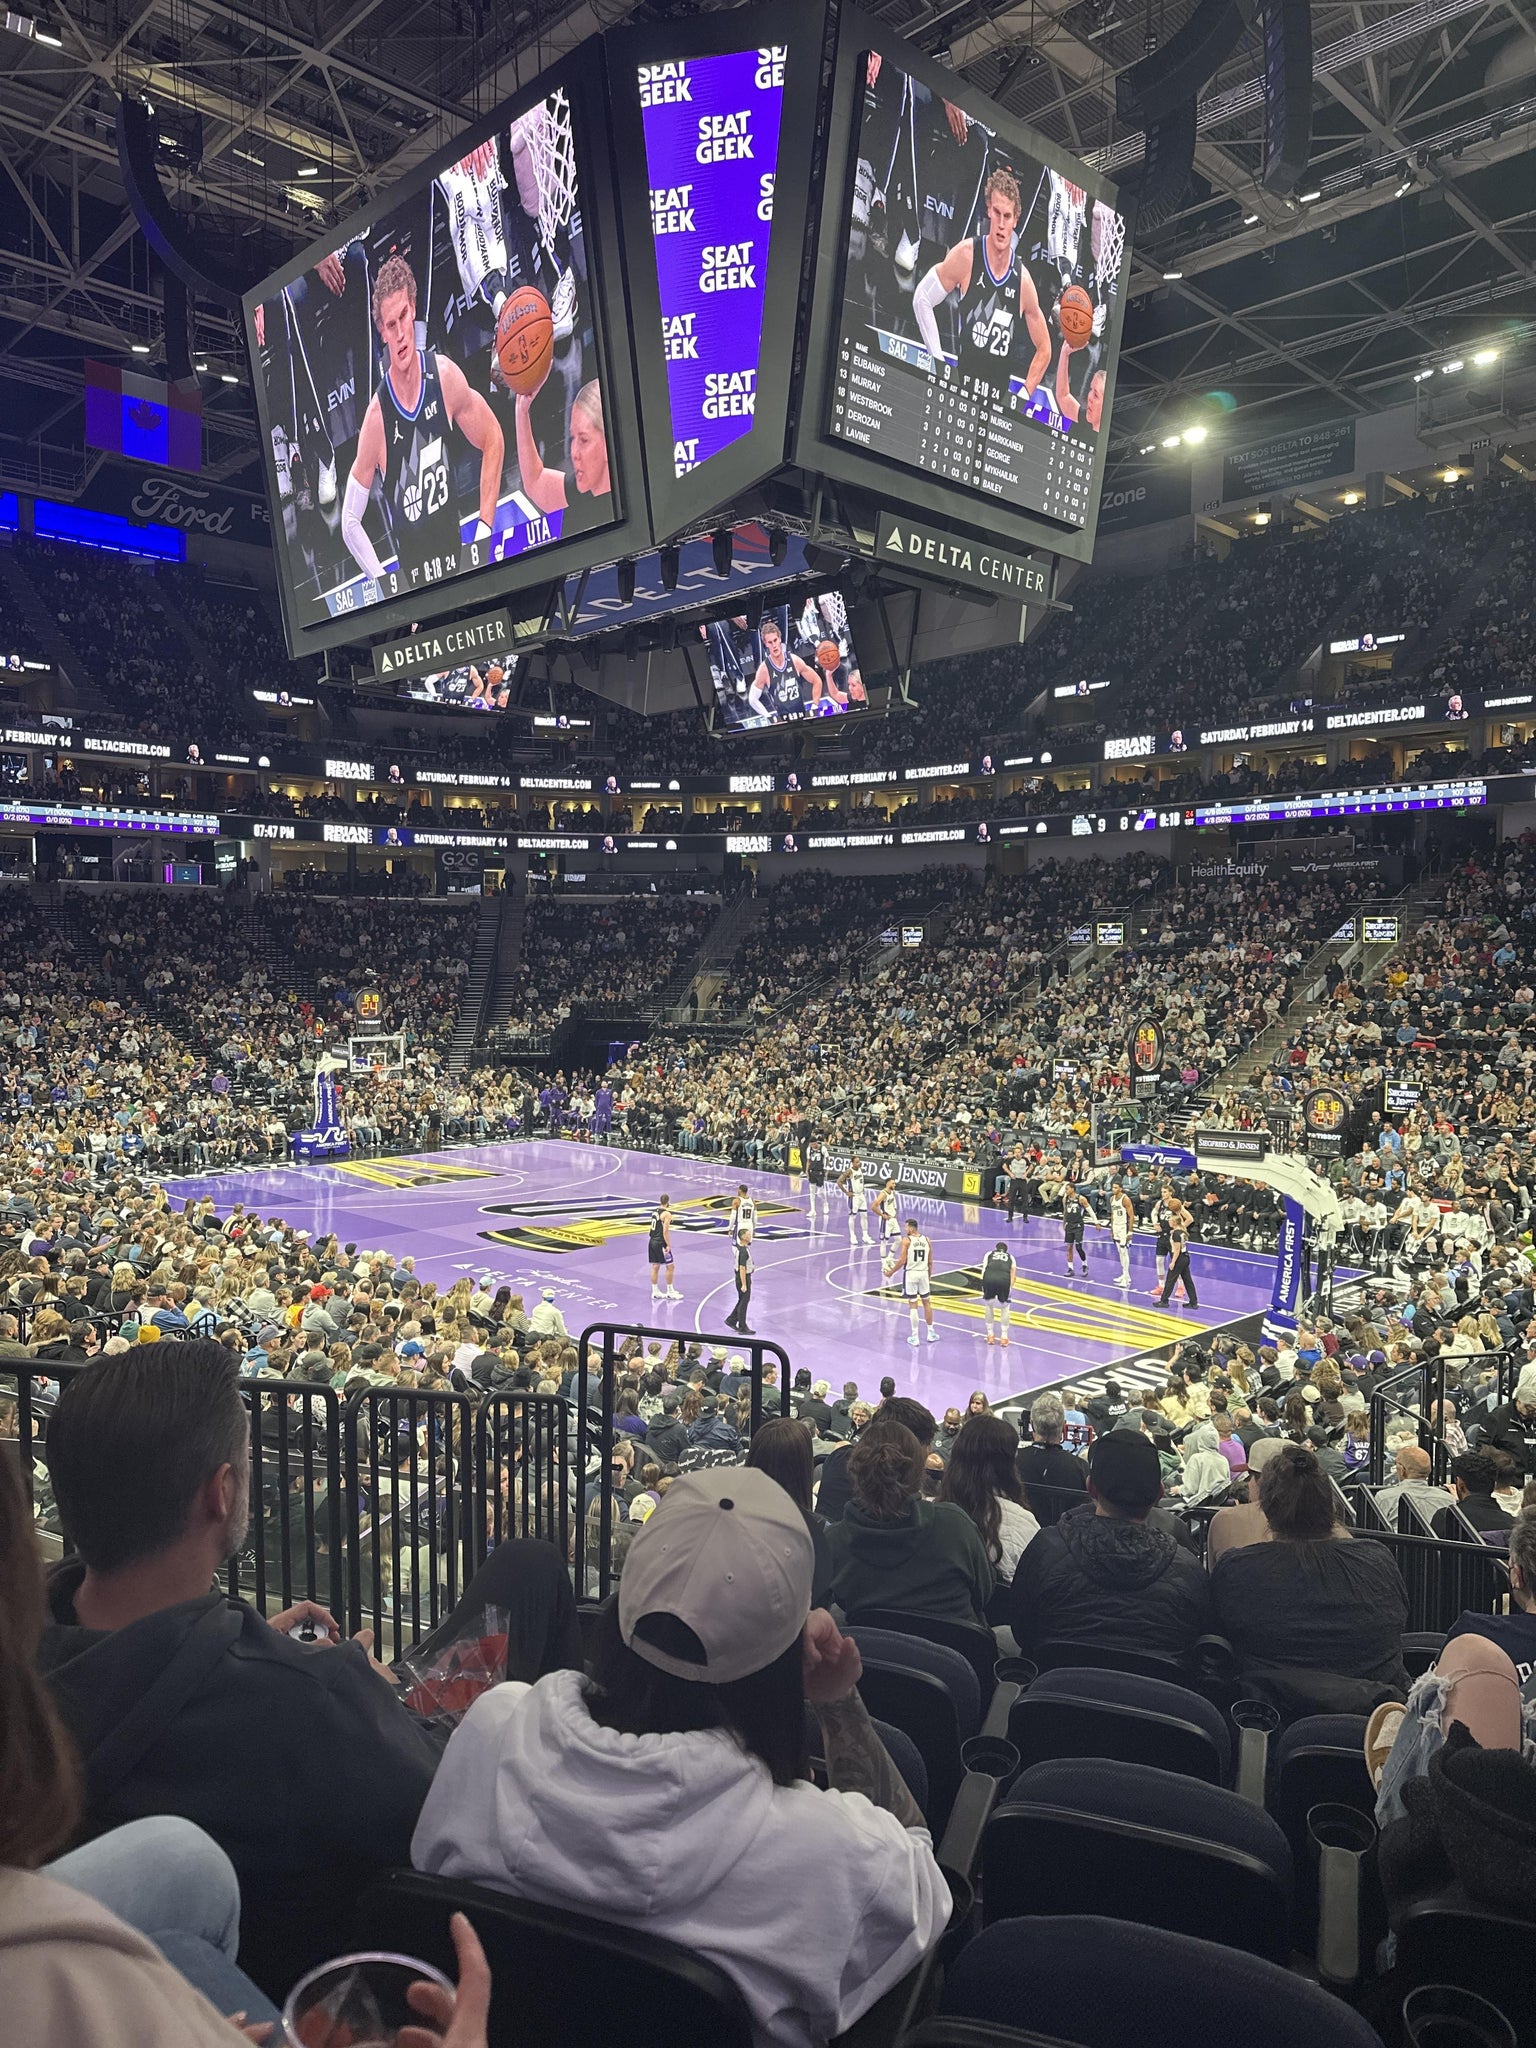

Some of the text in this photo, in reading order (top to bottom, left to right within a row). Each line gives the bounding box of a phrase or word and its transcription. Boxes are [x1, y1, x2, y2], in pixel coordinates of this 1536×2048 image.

[757, 45, 787, 65] SE
[638, 61, 686, 83] SEAT
[755, 64, 785, 90] GE
[640, 78, 693, 108] GEEK
[698, 110, 752, 140] SEAT
[696, 134, 754, 165] GEEK
[653, 208, 696, 235] EEK
[702, 241, 754, 270] SEAT
[699, 264, 756, 293] GEEK
[501, 302, 538, 334] Wilson
[661, 312, 697, 337] EAT
[664, 336, 699, 360] EEK
[888, 338, 908, 360] SAC
[990, 326, 1011, 357] 23
[704, 368, 756, 397] SEAT
[840, 369, 881, 392] 13 MURRAY
[841, 351, 975, 416] 19 EUBANKS 0 0 0 03 0
[944, 364, 951, 380] 9
[974, 378, 989, 398] 8:18
[991, 387, 1000, 400] 24
[702, 391, 755, 420] GEEK
[838, 386, 892, 416] 18 WESTBROOK
[1010, 395, 1017, 410] 8
[836, 405, 880, 430] 10 DEROZAN
[980, 411, 988, 420] 30
[1048, 411, 1063, 431] UTA
[835, 423, 870, 444] 8 LAVINE
[978, 427, 985, 436] 23
[674, 438, 699, 461] AT
[978, 444, 1011, 464] 3 GEORGE
[1229, 452, 1250, 465] TEXT
[1251, 447, 1269, 460] SOS
[1270, 441, 1297, 454] DELTA
[1299, 436, 1312, 447] TO
[1471, 439, 1489, 449] HH
[975, 460, 981, 469] 10
[424, 464, 449, 514] 23
[973, 476, 1003, 493] 19 BAILEY
[131, 478, 234, 535] Ford
[1102, 487, 1146, 510] Zone
[525, 517, 551, 545] UTA
[470, 543, 479, 566] 8
[908, 533, 1044, 593] DELTA CENTER
[424, 561, 442, 582] 8:18
[445, 554, 456, 571] 24
[390, 575, 398, 593] 9
[588, 559, 776, 611] DELTA
[336, 588, 355, 612] SAC
[396, 621, 505, 667] DELTA CENTER
[1201, 706, 1425, 744] SATURDAY, FEBRUARY 14 DELTACENTER.COM
[6, 730, 170, 757] FEBRUARY 14 DELTACENTER.COM
[416, 772, 591, 790] SATURDAY, FEBRUARY 14 DELTACENTER.COM
[812, 763, 969, 787] SATURDAY, FEBRUARY 14 DELTACENTER.COM
[254, 824, 294, 839] 07:47 PM
[1098, 818, 1106, 832] 9
[1120, 816, 1129, 831] 8
[1160, 812, 1180, 828] 8:18
[414, 833, 589, 850] SATURDAY, FEBRUARY 14 DELTACENTER.COM
[808, 829, 965, 849] SATURDAY, FEBRUARY 14 DELTACENTER.COM
[441, 852, 479, 865] G2G
[1191, 864, 1267, 877] HealthEquity
[362, 1002, 377, 1015] 24
[1316, 1112, 1334, 1125] 24
[1237, 1142, 1259, 1150] JENSEN
[880, 1158, 892, 1180] &
[895, 1162, 947, 1187] JENSEN
[914, 1250, 925, 1262] 19
[1279, 1219, 1295, 1303] AMERICA FIRST
[471, 1267, 536, 1287] DELTA
[1355, 1450, 1368, 1460] 67
